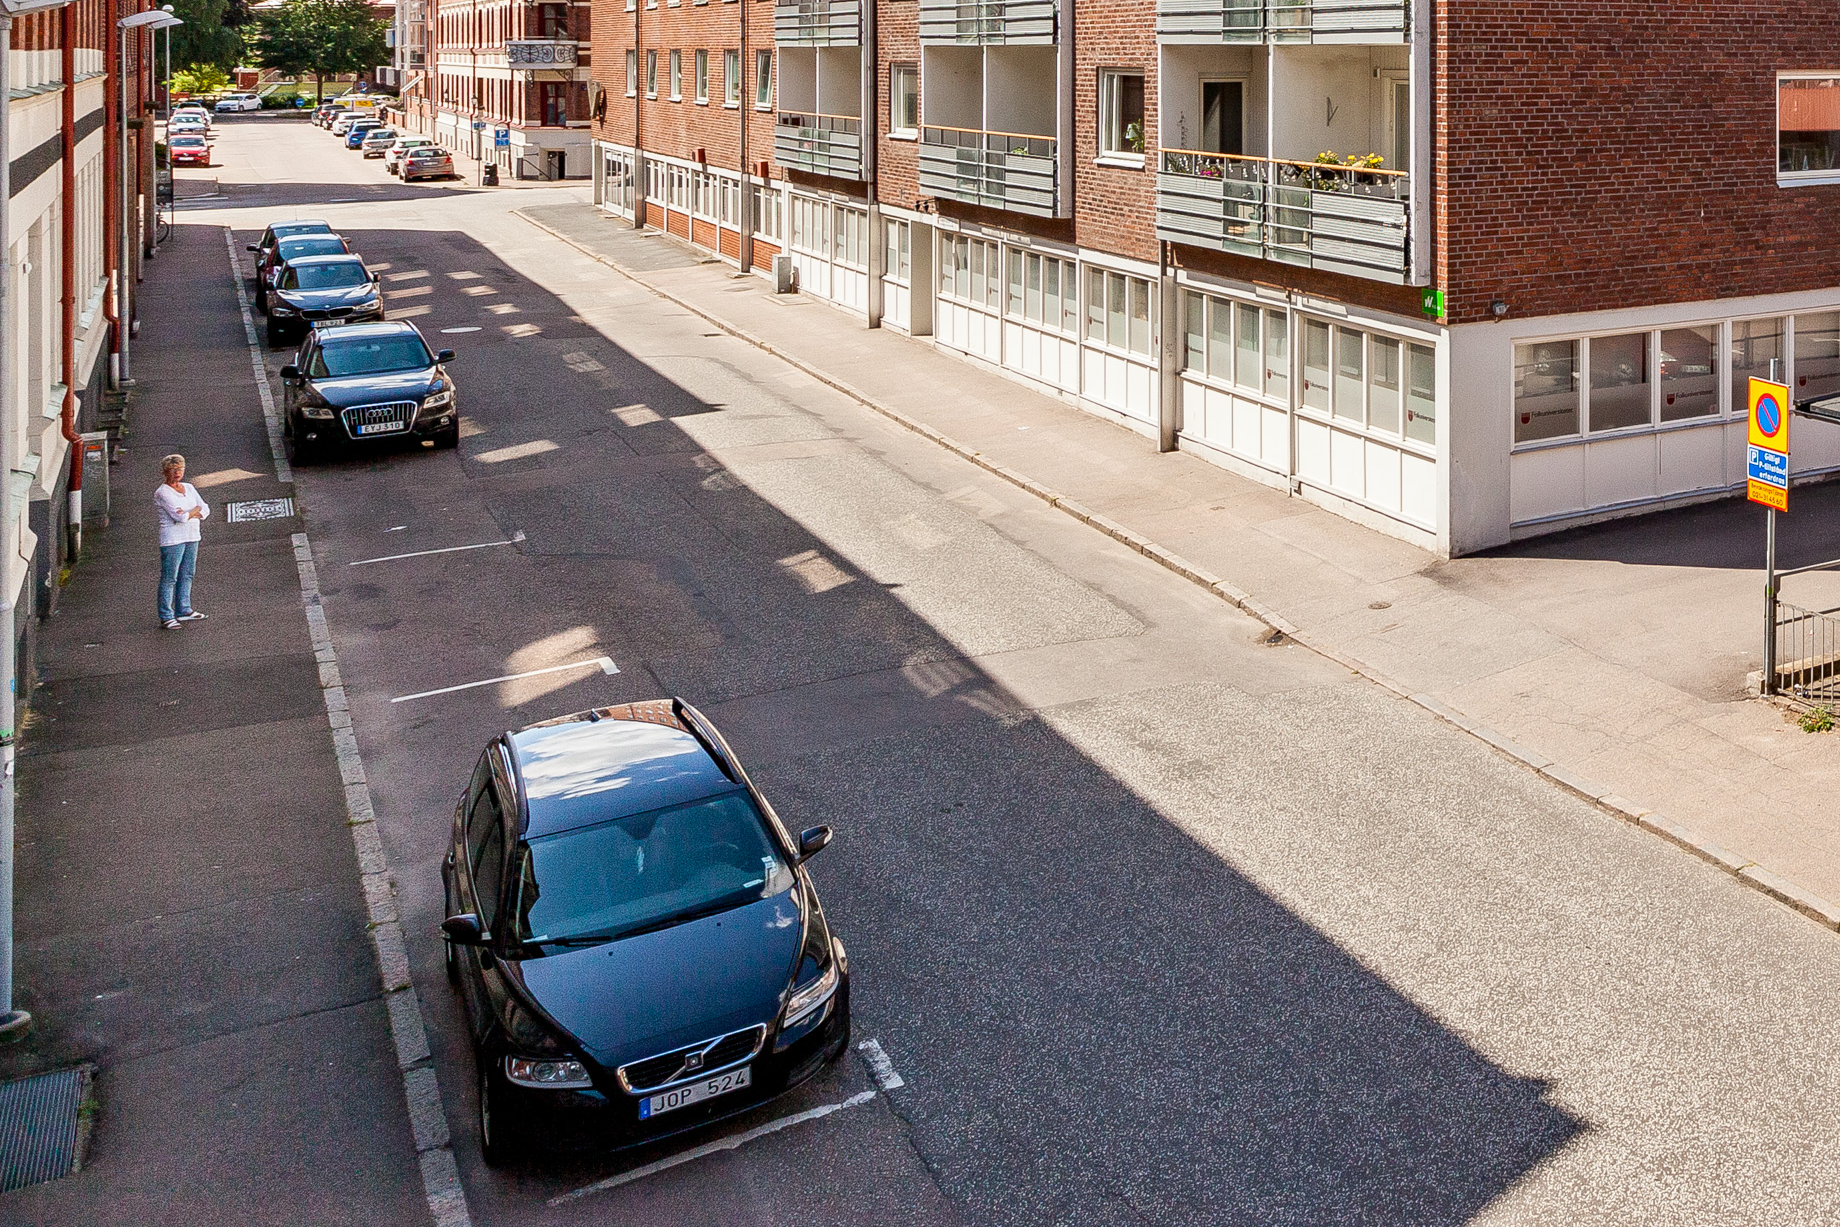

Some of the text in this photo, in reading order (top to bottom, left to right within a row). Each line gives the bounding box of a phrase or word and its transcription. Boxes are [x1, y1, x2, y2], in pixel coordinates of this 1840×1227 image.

[364, 422, 401, 433] EYJ 310
[654, 1070, 745, 1112] JOP 524
